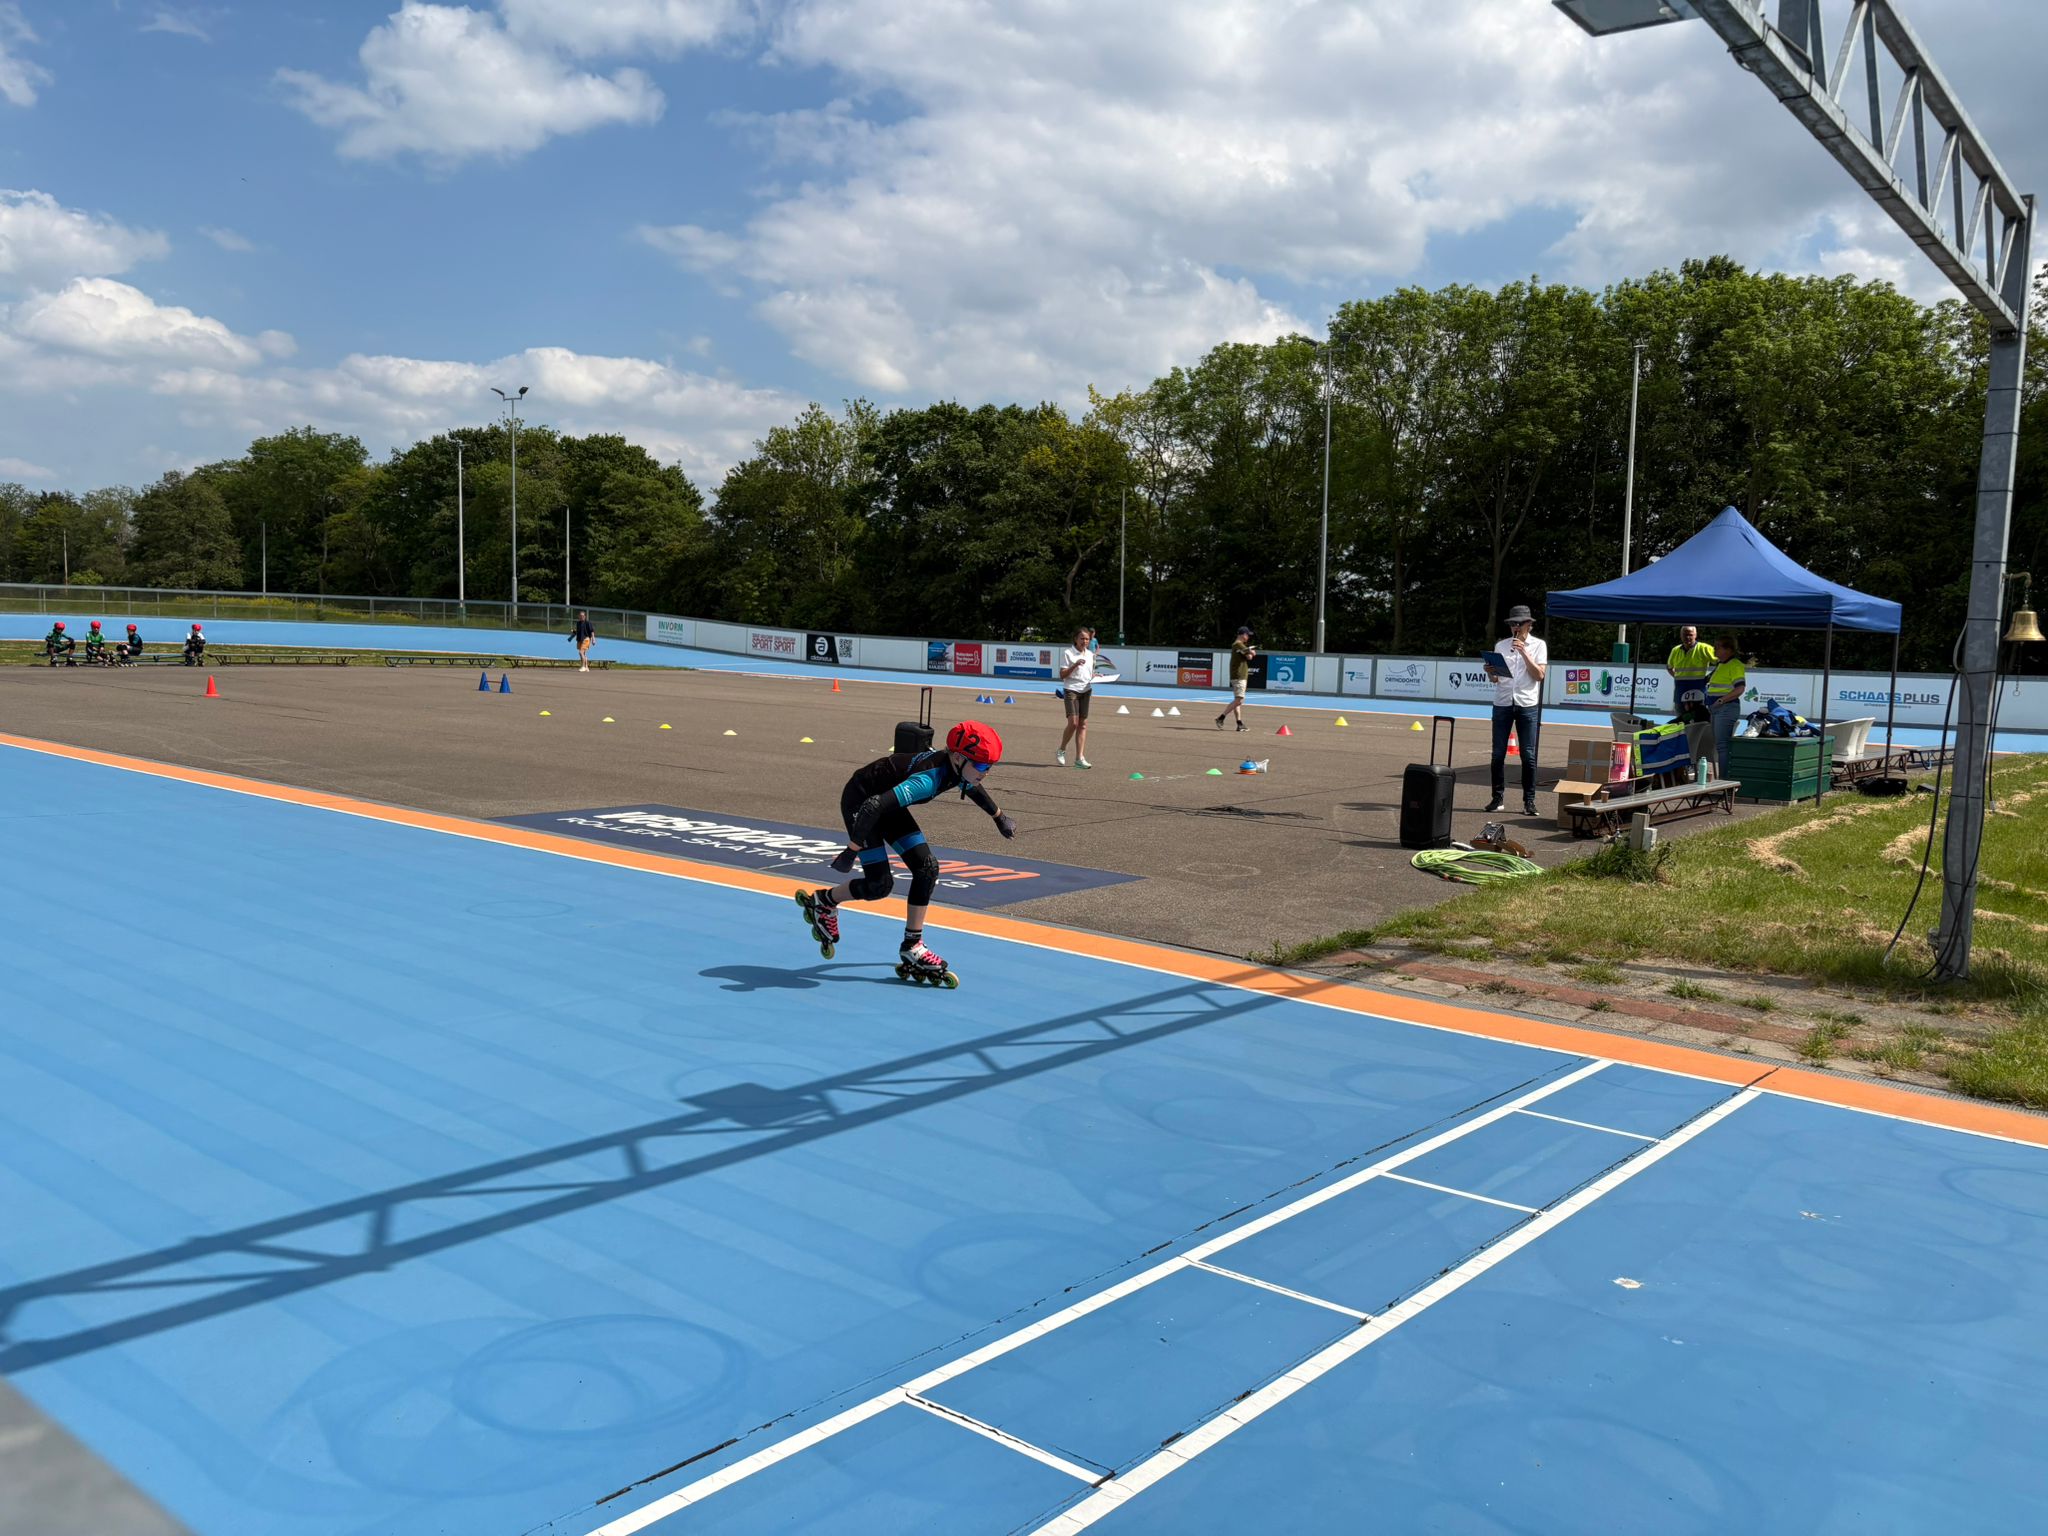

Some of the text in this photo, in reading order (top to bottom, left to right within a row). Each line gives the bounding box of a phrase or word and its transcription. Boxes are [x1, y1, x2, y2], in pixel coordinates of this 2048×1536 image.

[658, 620, 684, 633] INVORM
[752, 637, 773, 651] SPORT
[774, 640, 795, 653] SPORT
[1465, 673, 1487, 682] VAN
[1614, 674, 1659, 688] de ong
[1684, 692, 1695, 700] 01
[956, 730, 980, 756] 12
